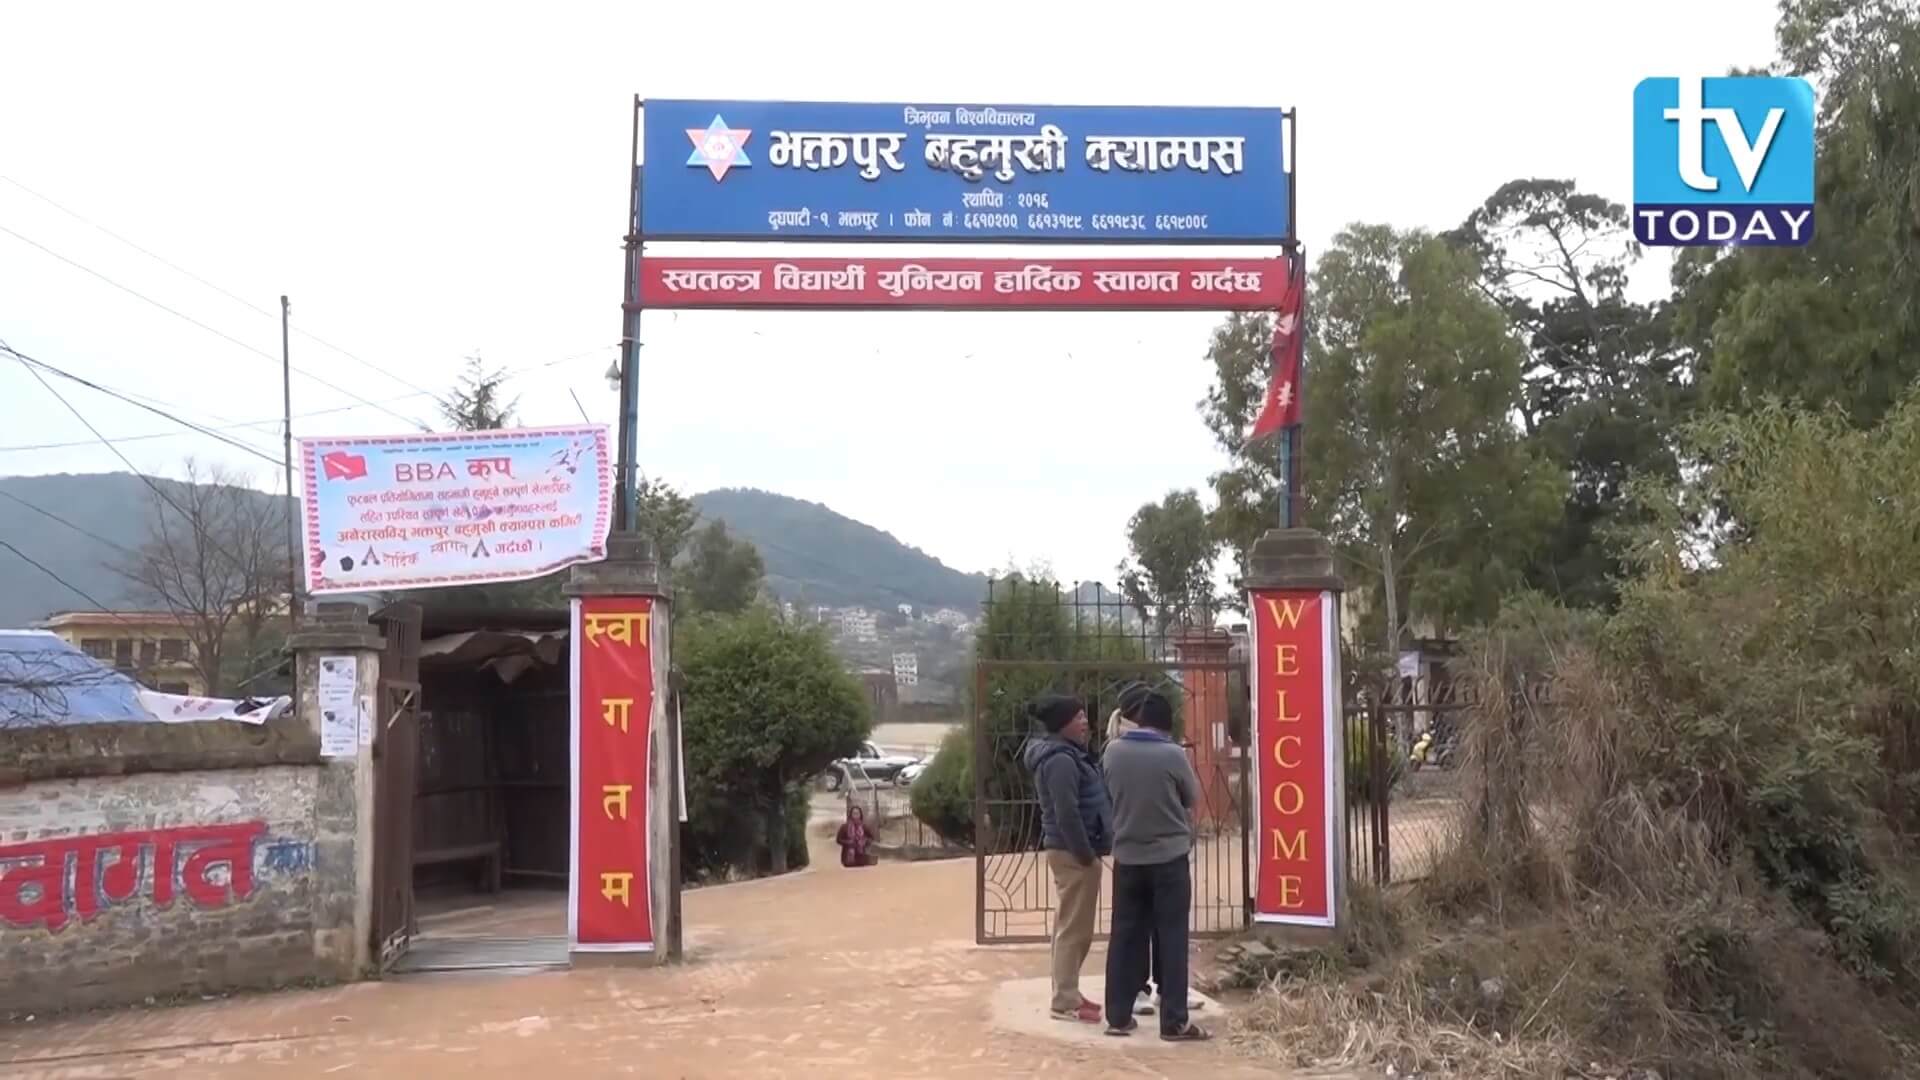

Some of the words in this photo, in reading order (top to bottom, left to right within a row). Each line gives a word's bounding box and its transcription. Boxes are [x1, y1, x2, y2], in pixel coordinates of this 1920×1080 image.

[903, 106, 951, 128] त्रिभुवन
[955, 106, 1036, 127] विश्वविद्यालय
[768, 130, 907, 181] भक्तपुर
[924, 124, 1069, 183] बहुमुखी
[1085, 135, 1246, 175] क्याम्पस
[962, 187, 1003, 208] स्थापित
[1018, 193, 1049, 209] २०१६
[838, 210, 880, 230] भक्तपुर
[904, 208, 931, 228] फोन
[661, 269, 762, 292] स्वतन्त्र
[774, 263, 866, 291] विद्यार्थी
[877, 264, 983, 297] युनियन
[994, 265, 1082, 293] हार्दिक
[1093, 270, 1181, 293] स्वागत
[1191, 266, 1263, 293] गर्दछ
[395, 462, 457, 483] BBA
[466, 456, 516, 481] कप
[1267, 598, 1310, 909] WELCOME
